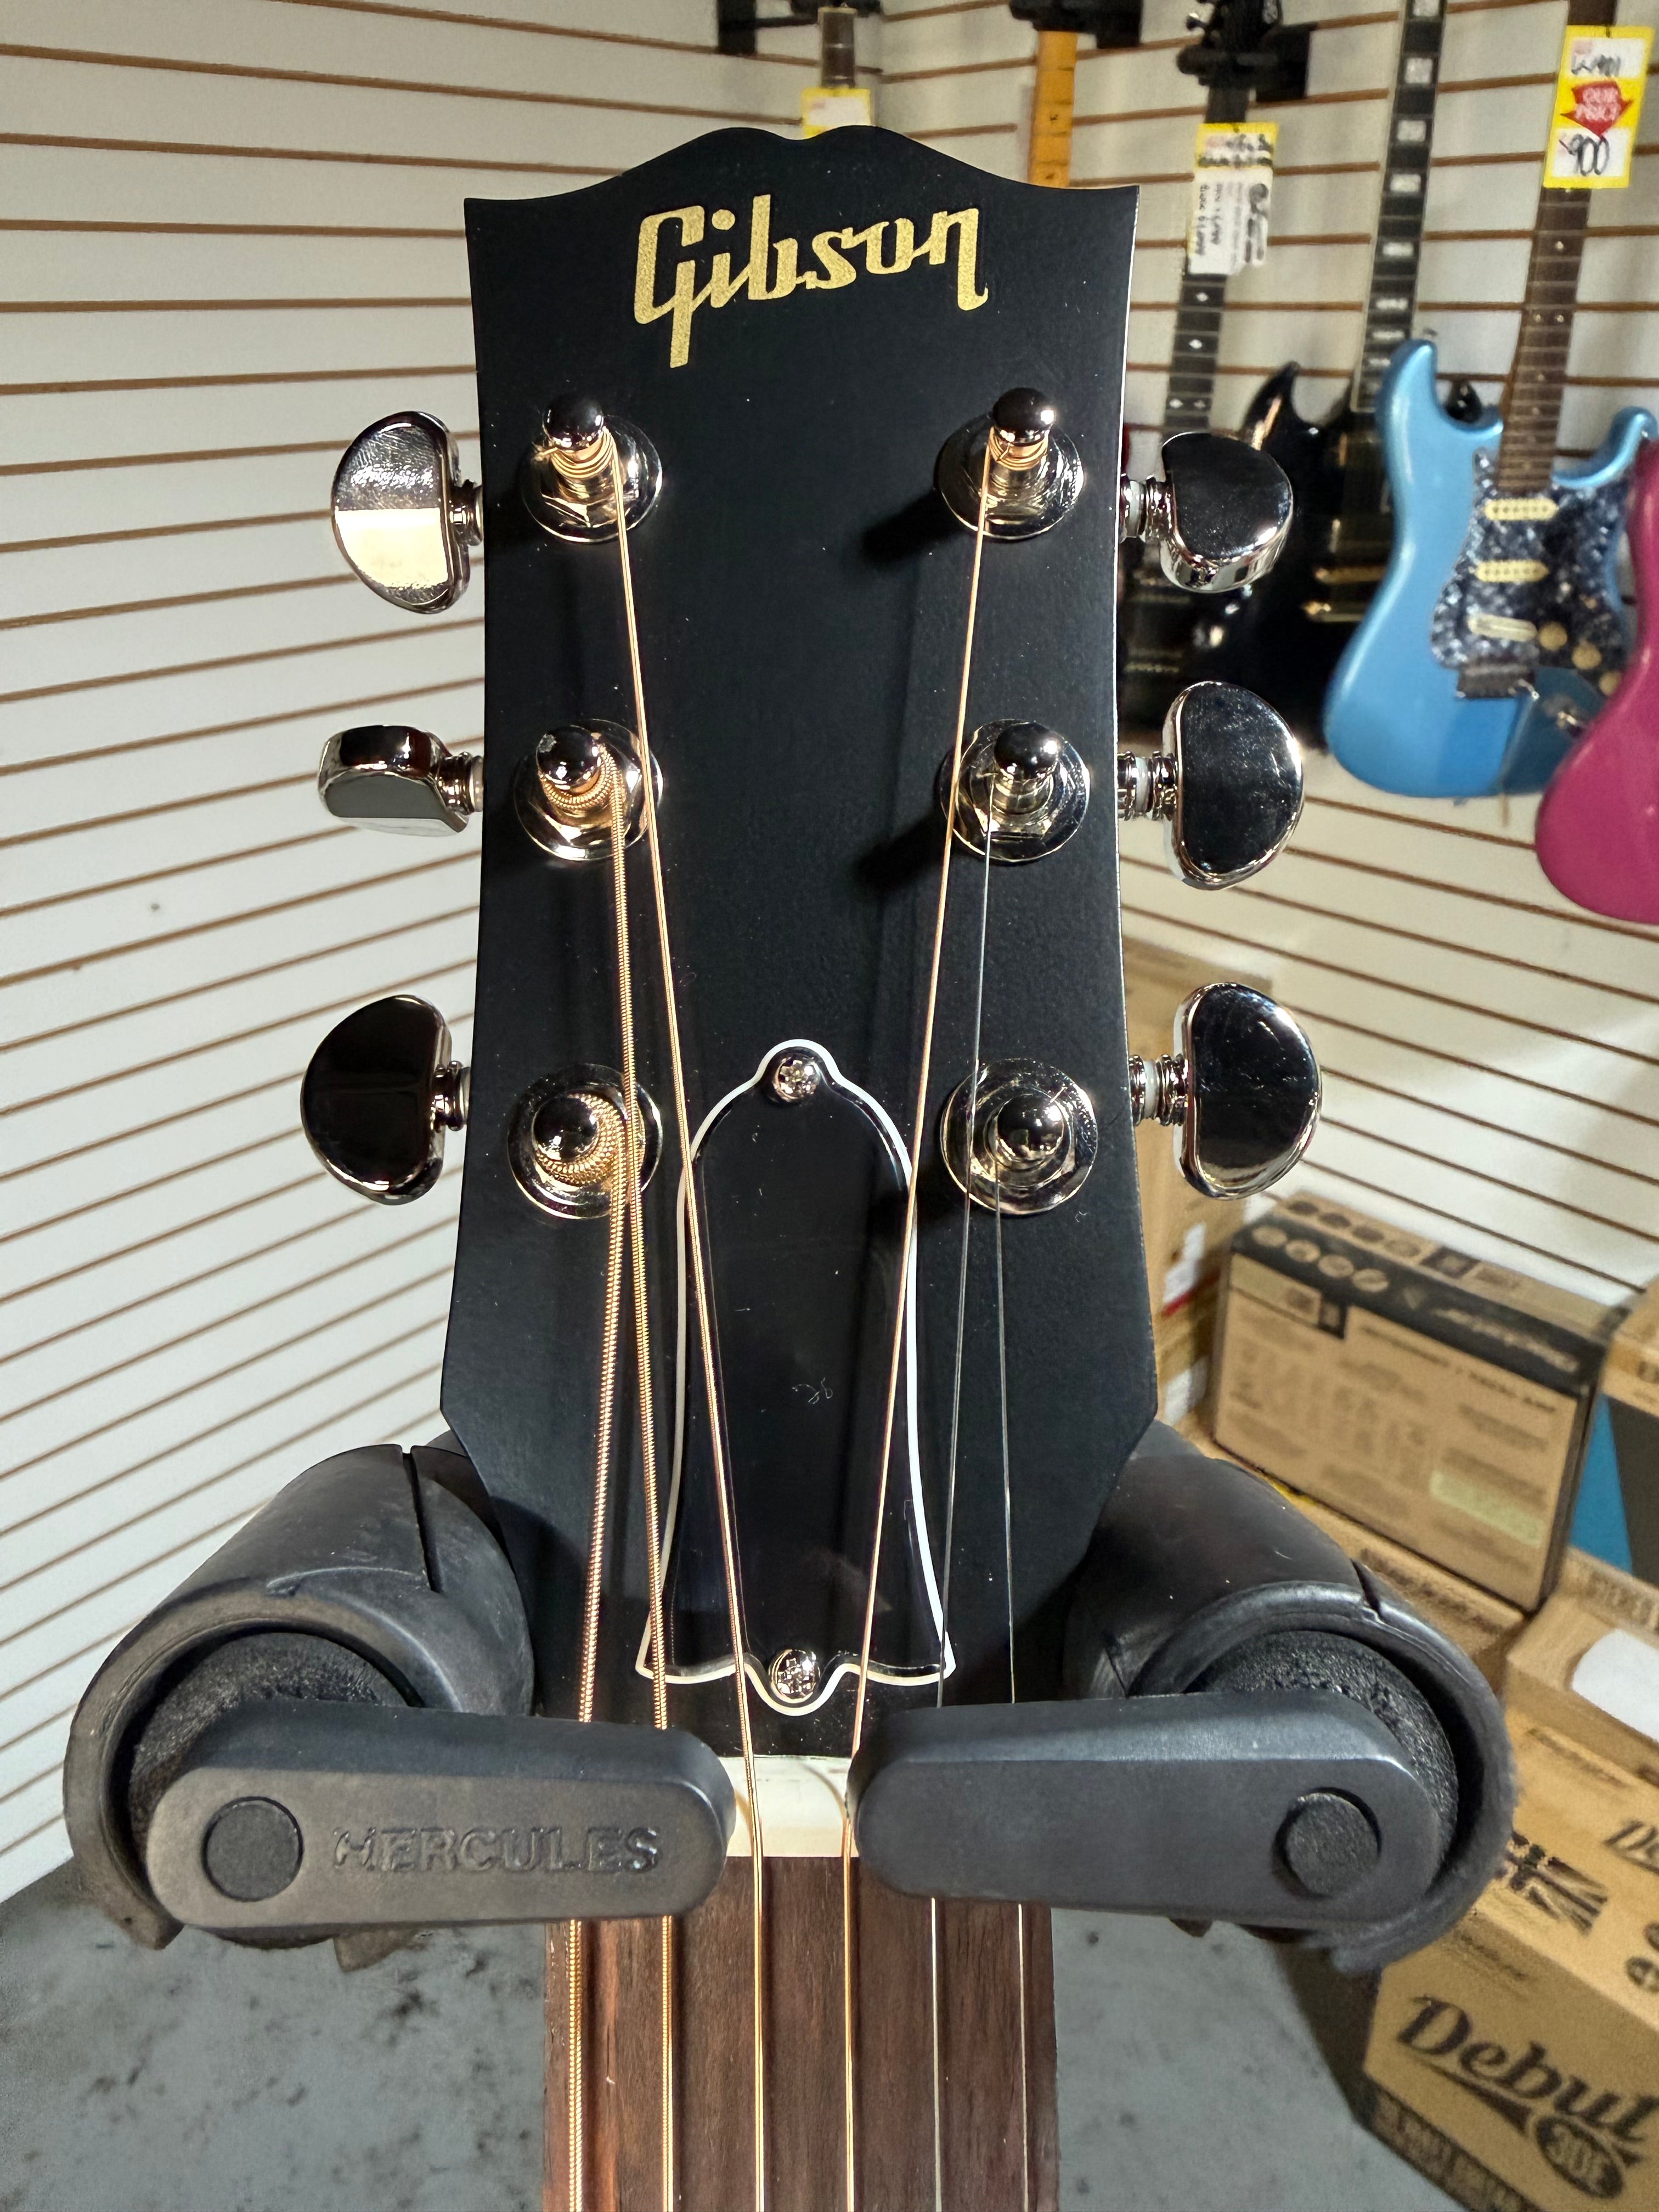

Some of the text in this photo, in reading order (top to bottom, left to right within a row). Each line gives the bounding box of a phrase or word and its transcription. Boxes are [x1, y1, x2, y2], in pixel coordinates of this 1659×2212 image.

[634, 194, 988, 368] Gibson
[332, 1826, 662, 1872] HERCULES
[1395, 1995, 1659, 2144] Debut
